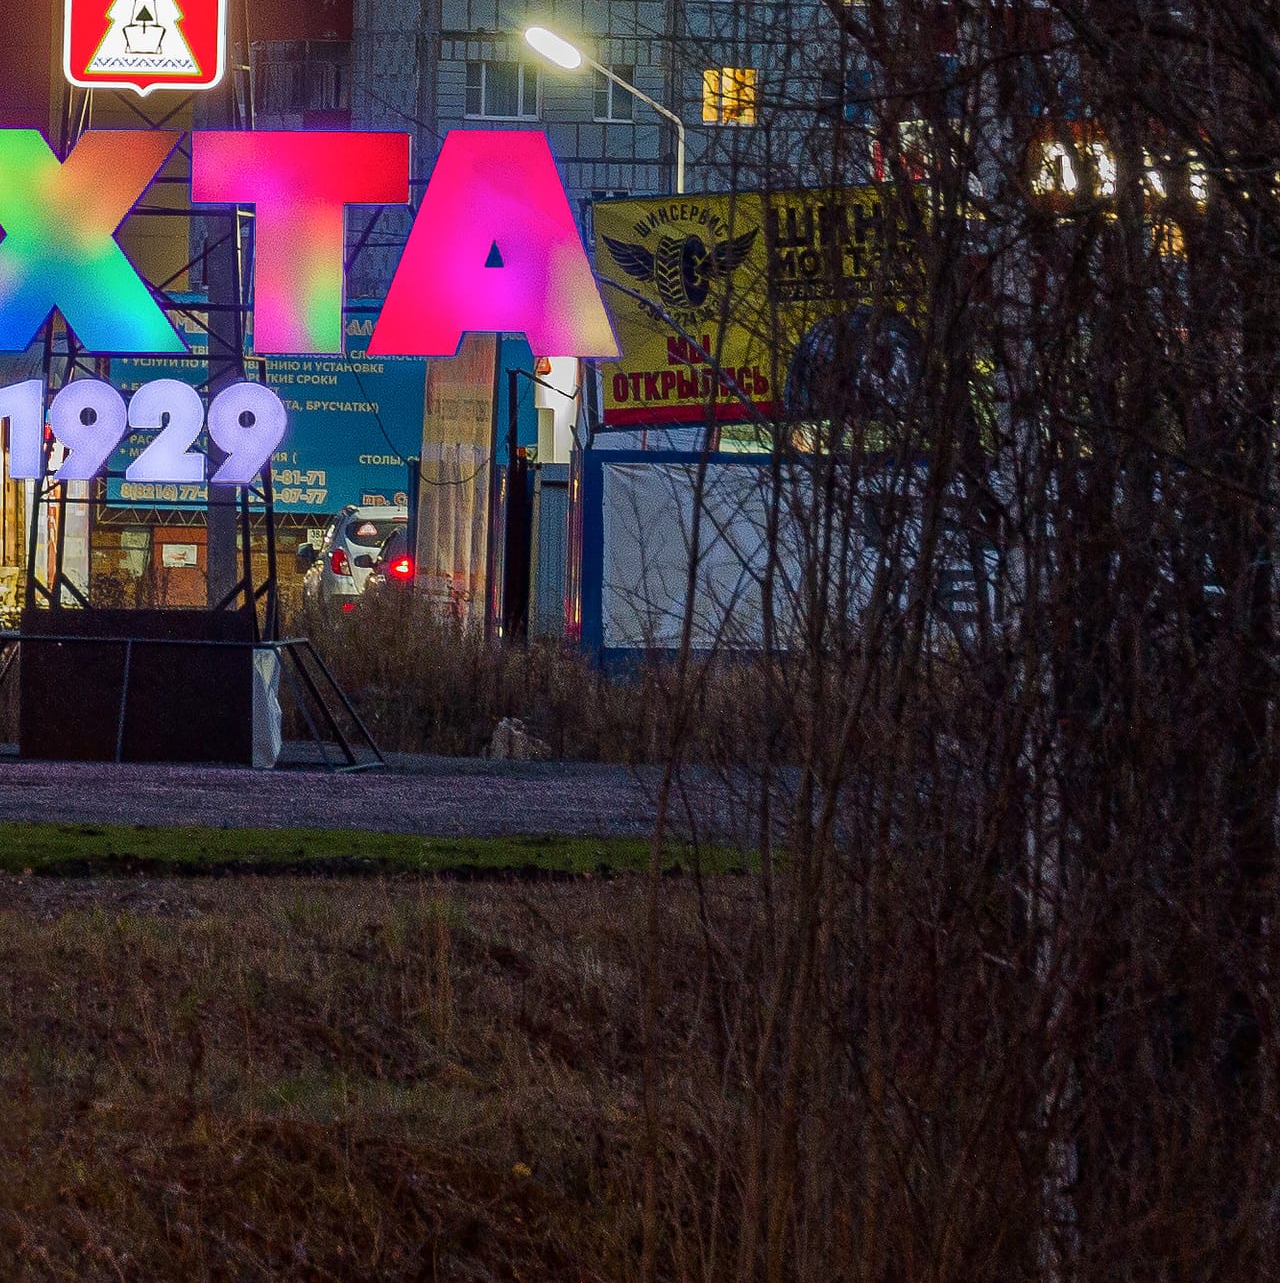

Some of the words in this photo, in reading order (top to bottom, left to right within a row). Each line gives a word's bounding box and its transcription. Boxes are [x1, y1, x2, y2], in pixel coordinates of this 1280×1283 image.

[666, 334, 711, 365] МЫ
[315, 362, 385, 373] УСТАНОВКЕ
[296, 375, 338, 385] СРОКИ
